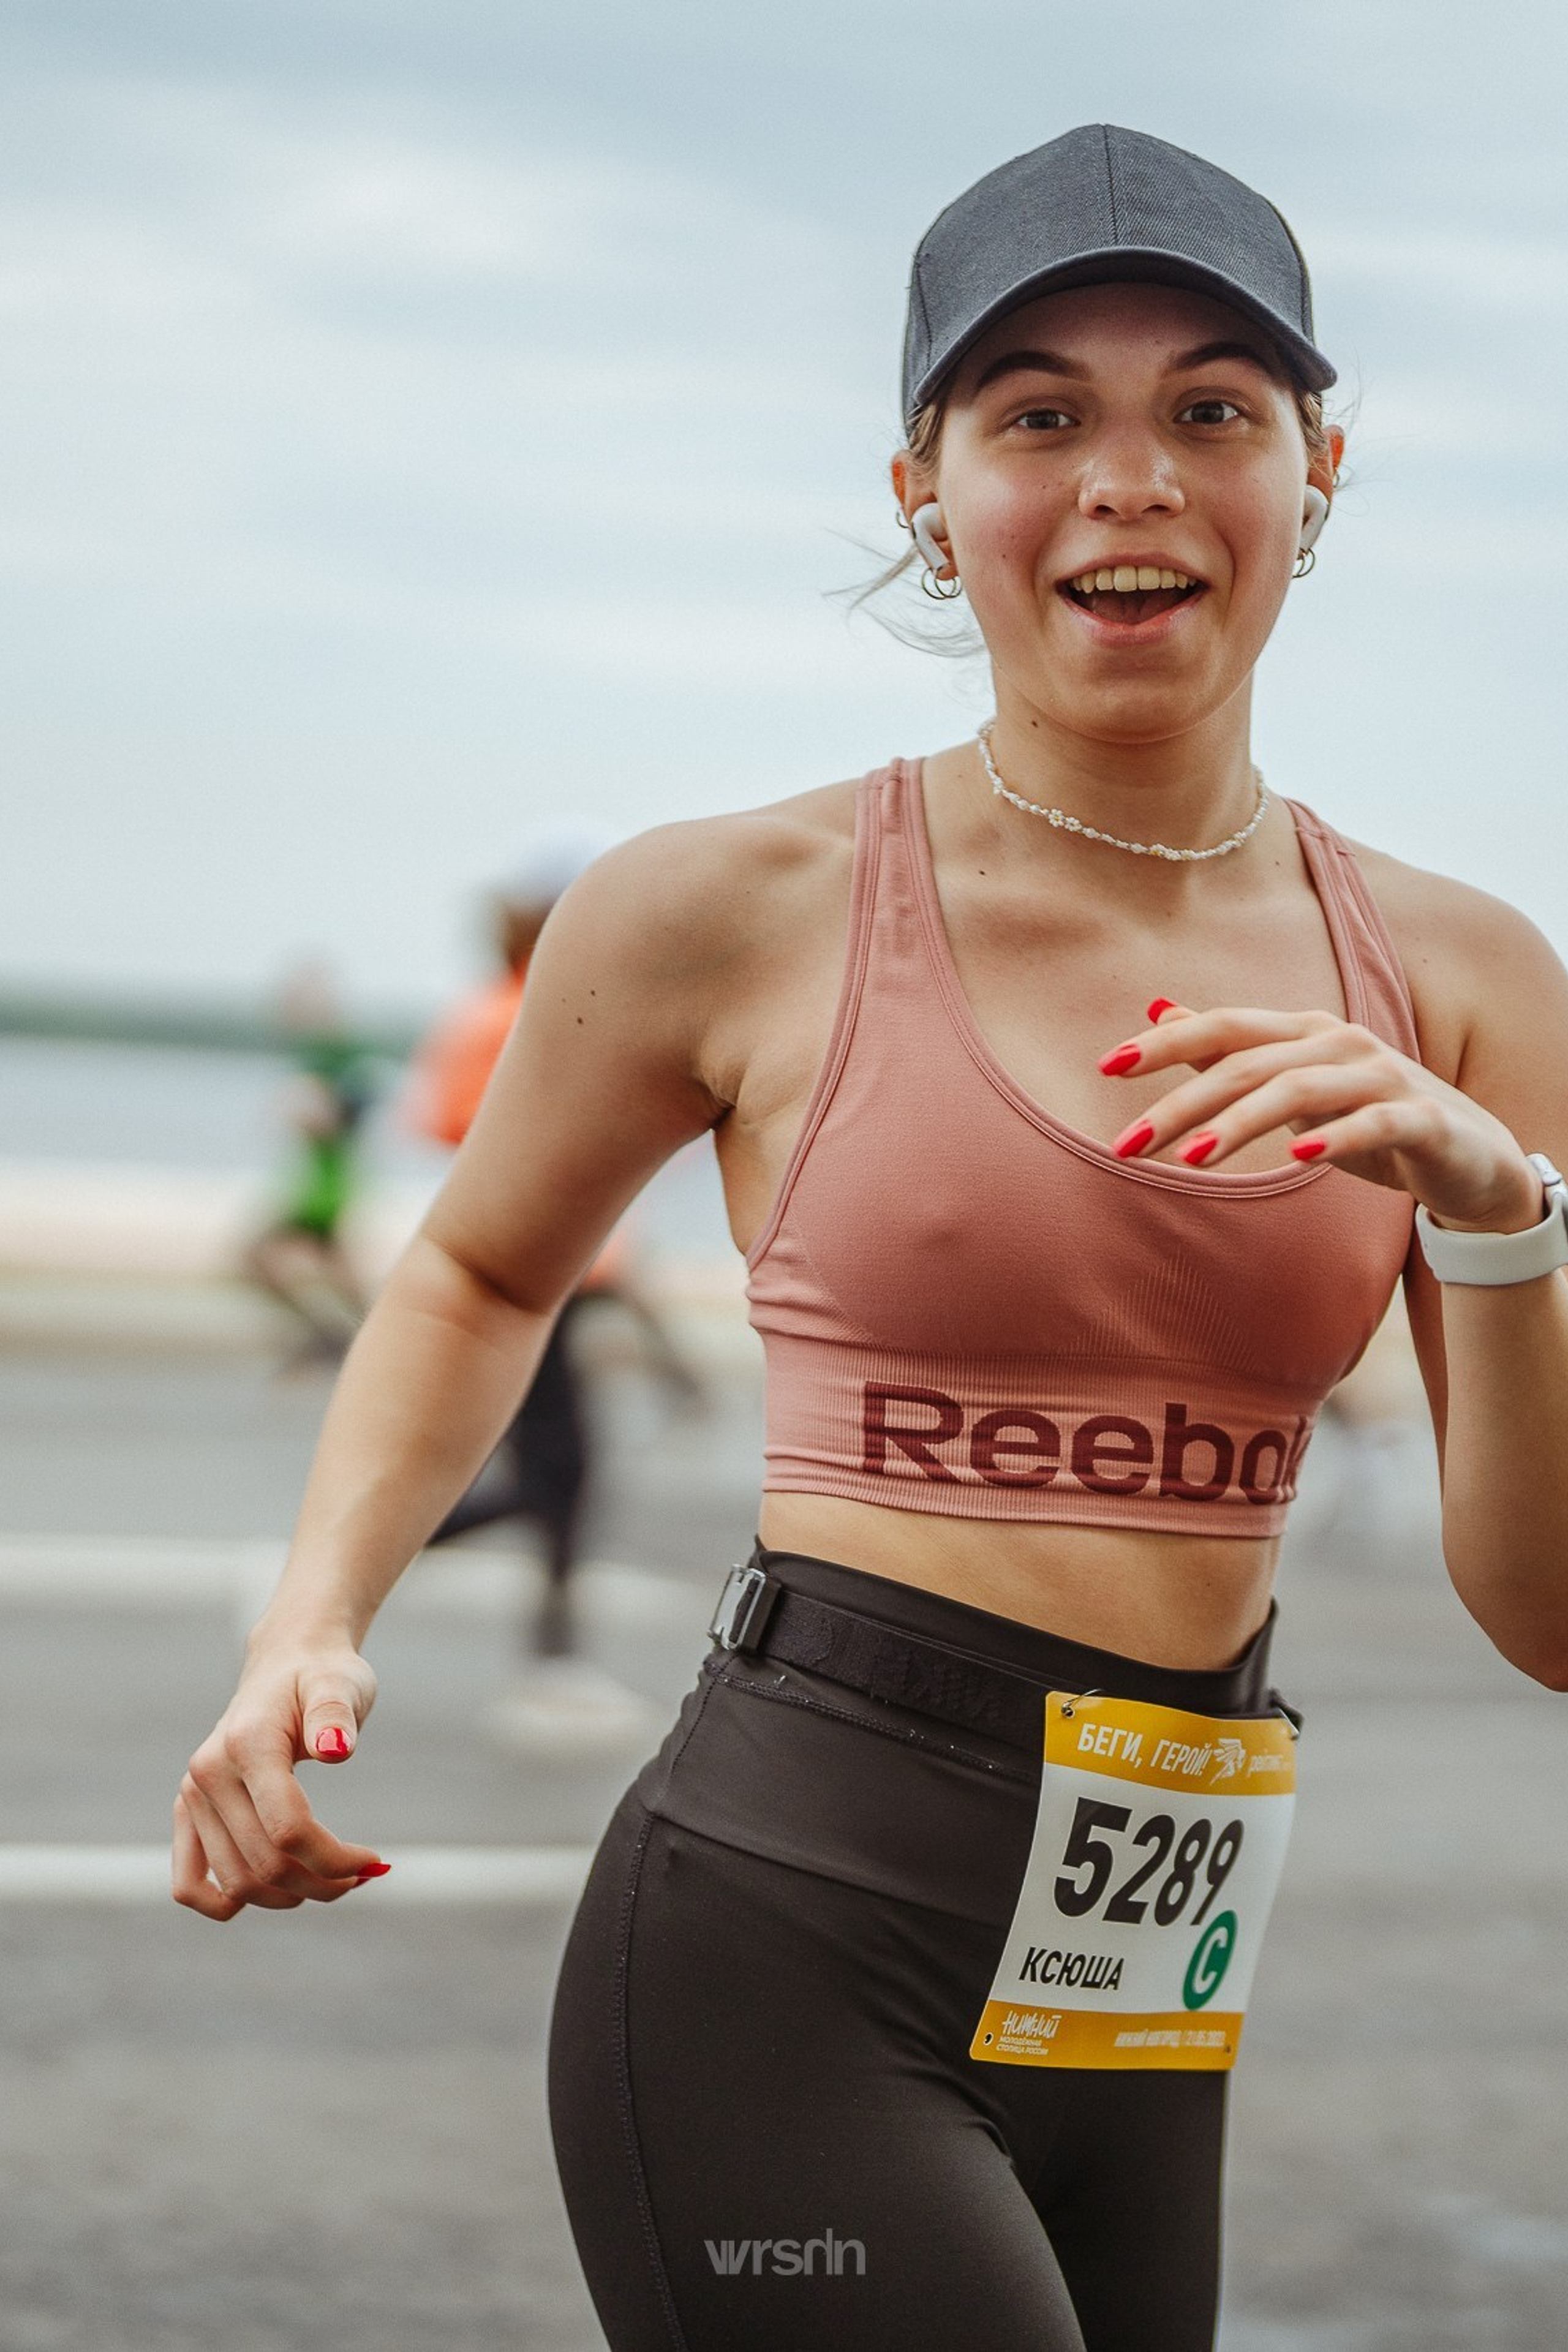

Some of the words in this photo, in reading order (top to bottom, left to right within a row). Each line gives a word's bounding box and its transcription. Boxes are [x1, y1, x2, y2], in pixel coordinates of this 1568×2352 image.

[1077, 1722, 1143, 1768] БЕГИ,
[1150, 1738, 1213, 1776] ГЕРОЙ!
[1054, 1796, 1245, 1927] 5289
[1019, 1946, 1125, 1991] КСЮША
